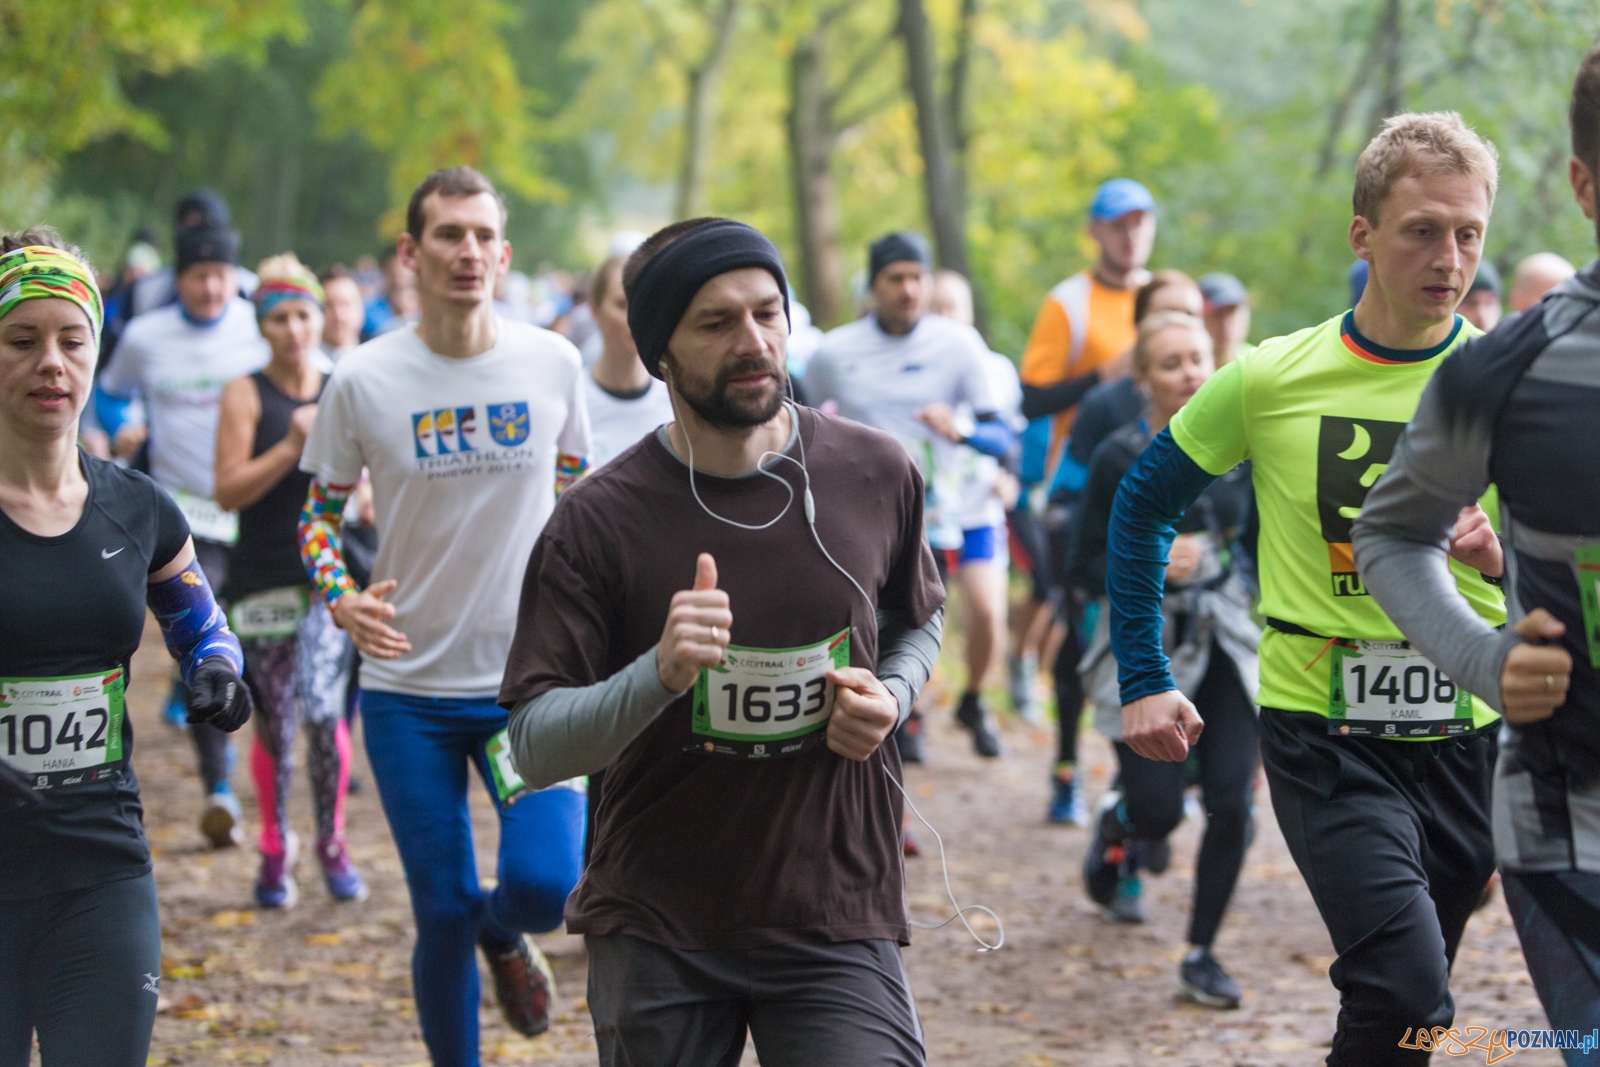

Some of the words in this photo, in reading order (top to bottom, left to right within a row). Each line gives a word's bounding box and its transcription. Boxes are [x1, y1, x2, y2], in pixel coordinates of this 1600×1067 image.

[418, 448, 533, 471] TRIATHLON
[427, 464, 482, 480] PNIEWY
[487, 461, 522, 474] 2014
[1351, 664, 1456, 704] 1408
[722, 676, 827, 723] 1633
[1391, 709, 1422, 719] KAMIL
[0, 707, 109, 756] 1042
[42, 758, 76, 770] HANIA
